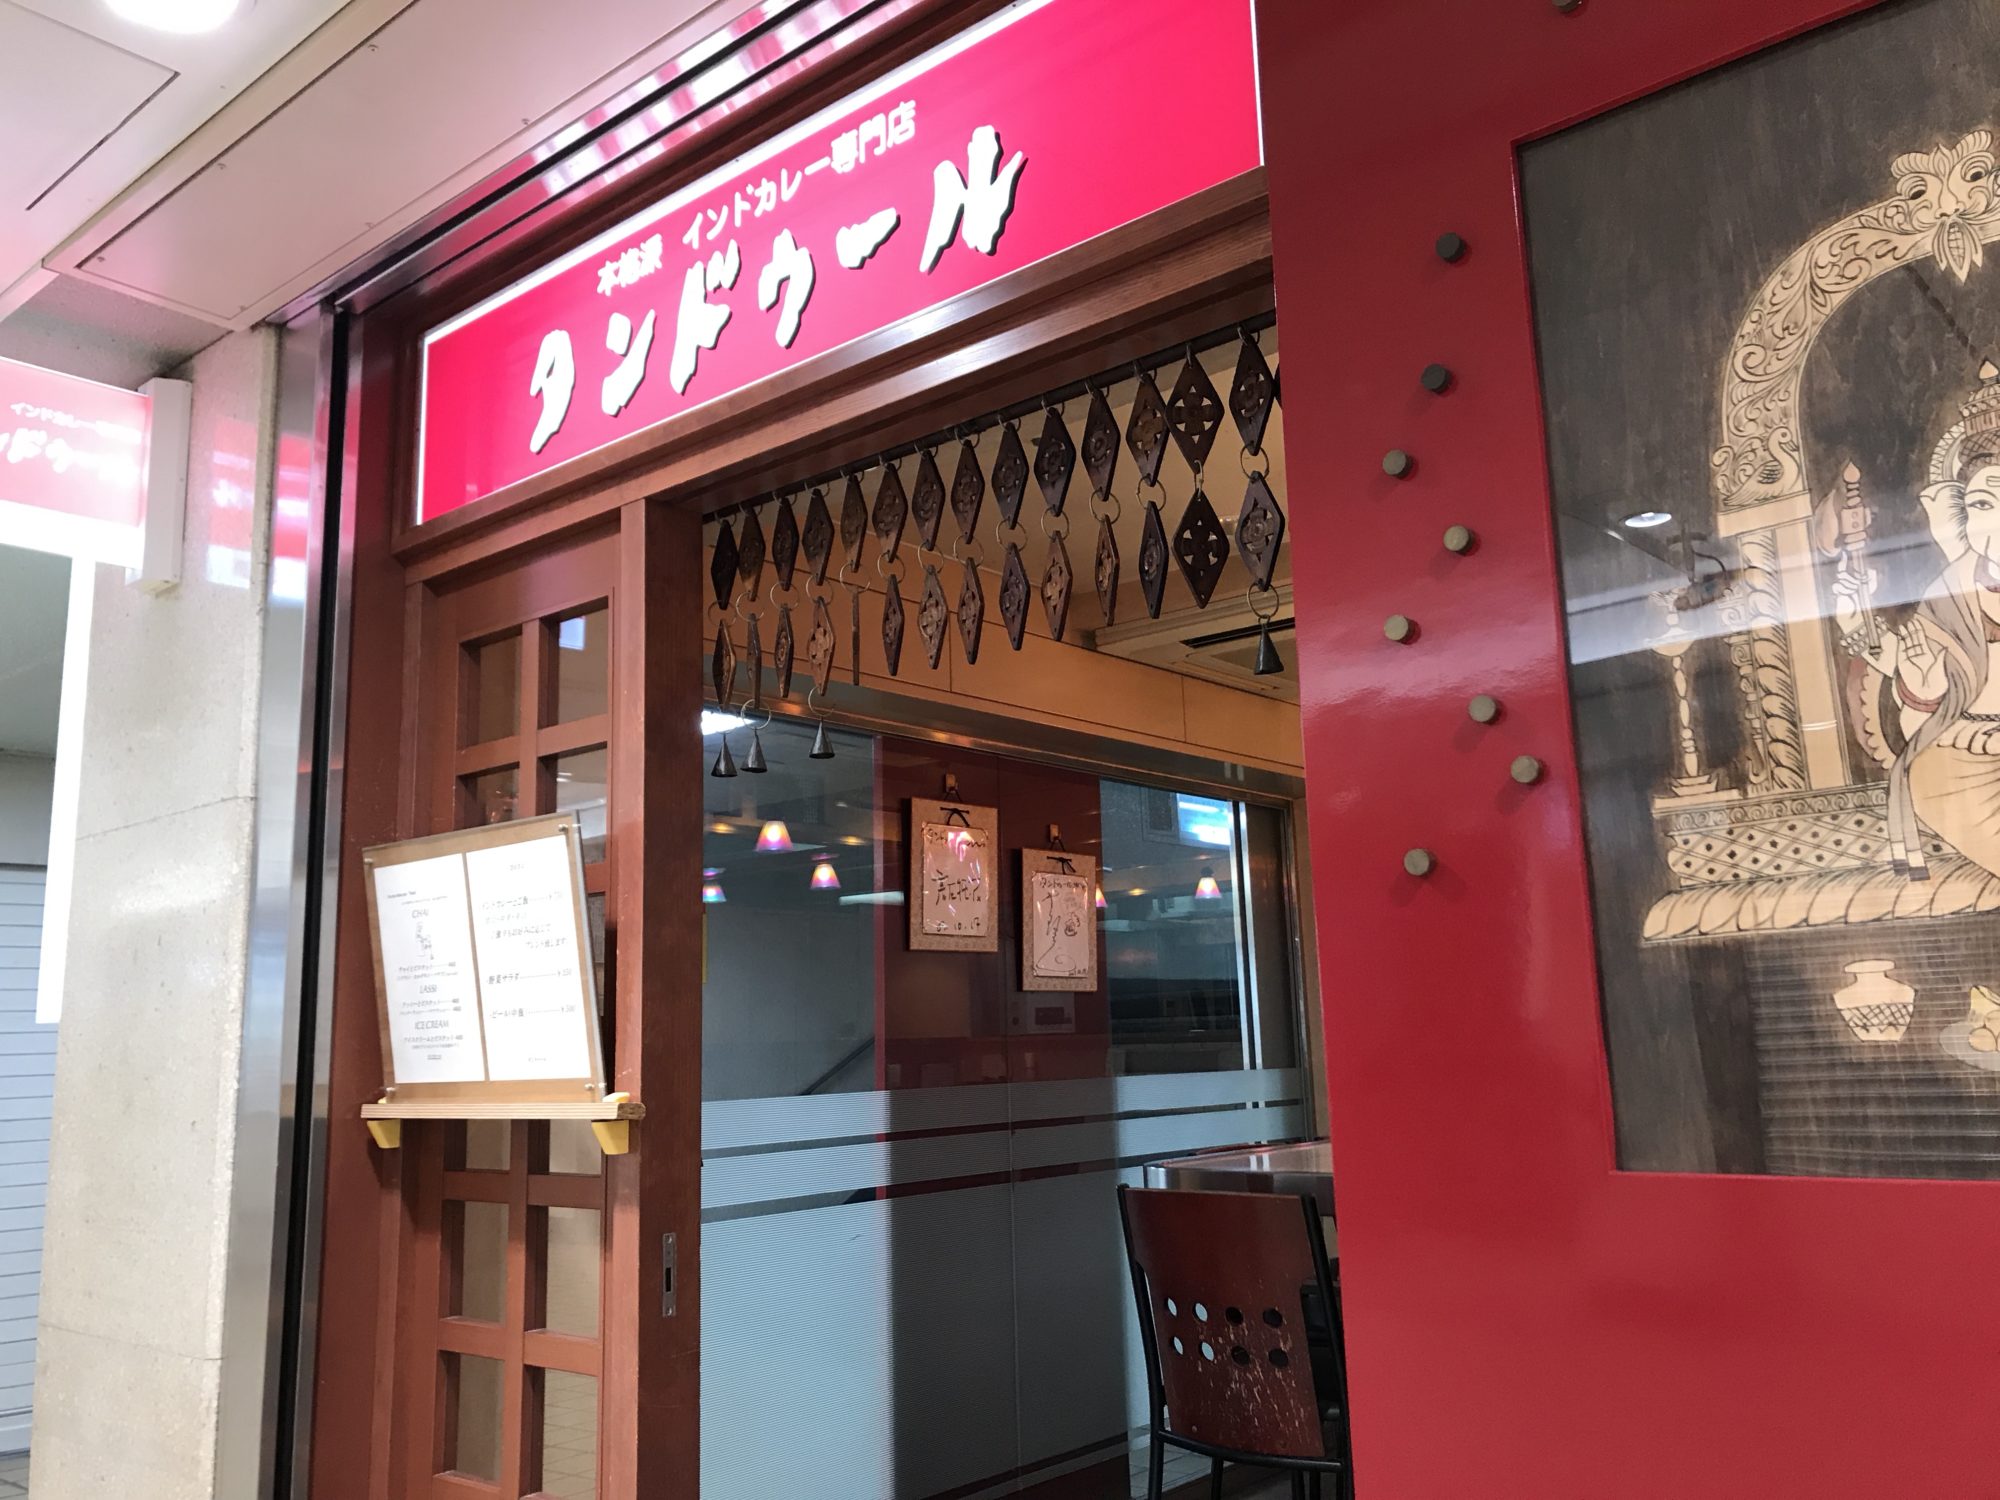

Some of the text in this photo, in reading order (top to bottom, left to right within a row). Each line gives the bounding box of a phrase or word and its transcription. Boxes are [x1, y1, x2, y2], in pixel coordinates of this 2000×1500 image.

[598, 100, 917, 295] 本格派 インドカレー専門店
[419, 984, 438, 994] LASSI
